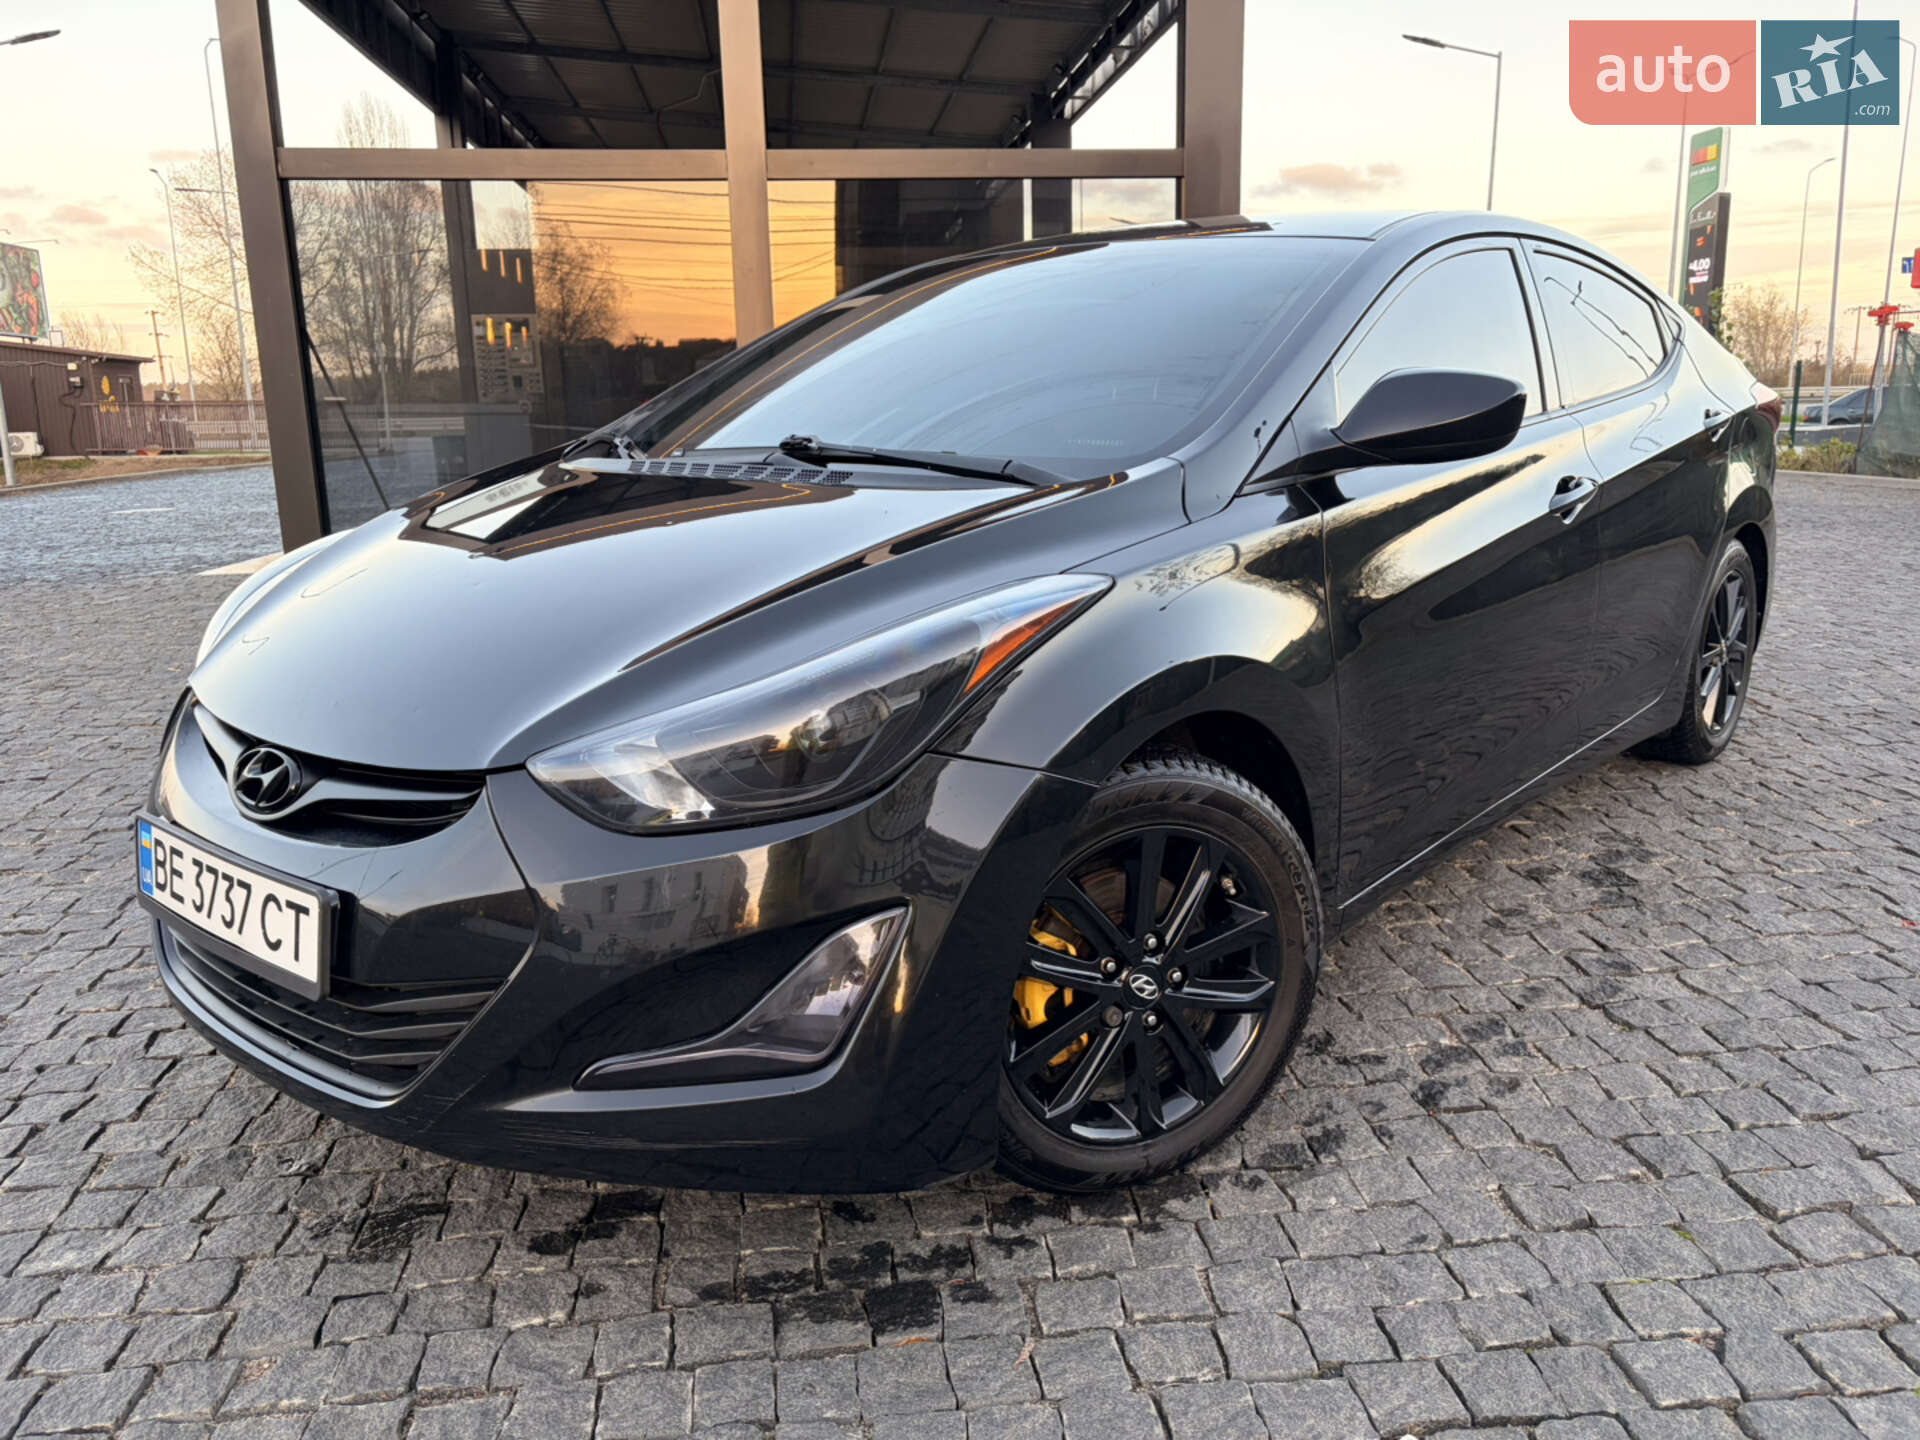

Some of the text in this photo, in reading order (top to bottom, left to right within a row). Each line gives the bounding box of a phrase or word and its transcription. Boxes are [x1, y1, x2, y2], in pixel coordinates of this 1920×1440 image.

[154, 837, 310, 963] BE 3737 CT
